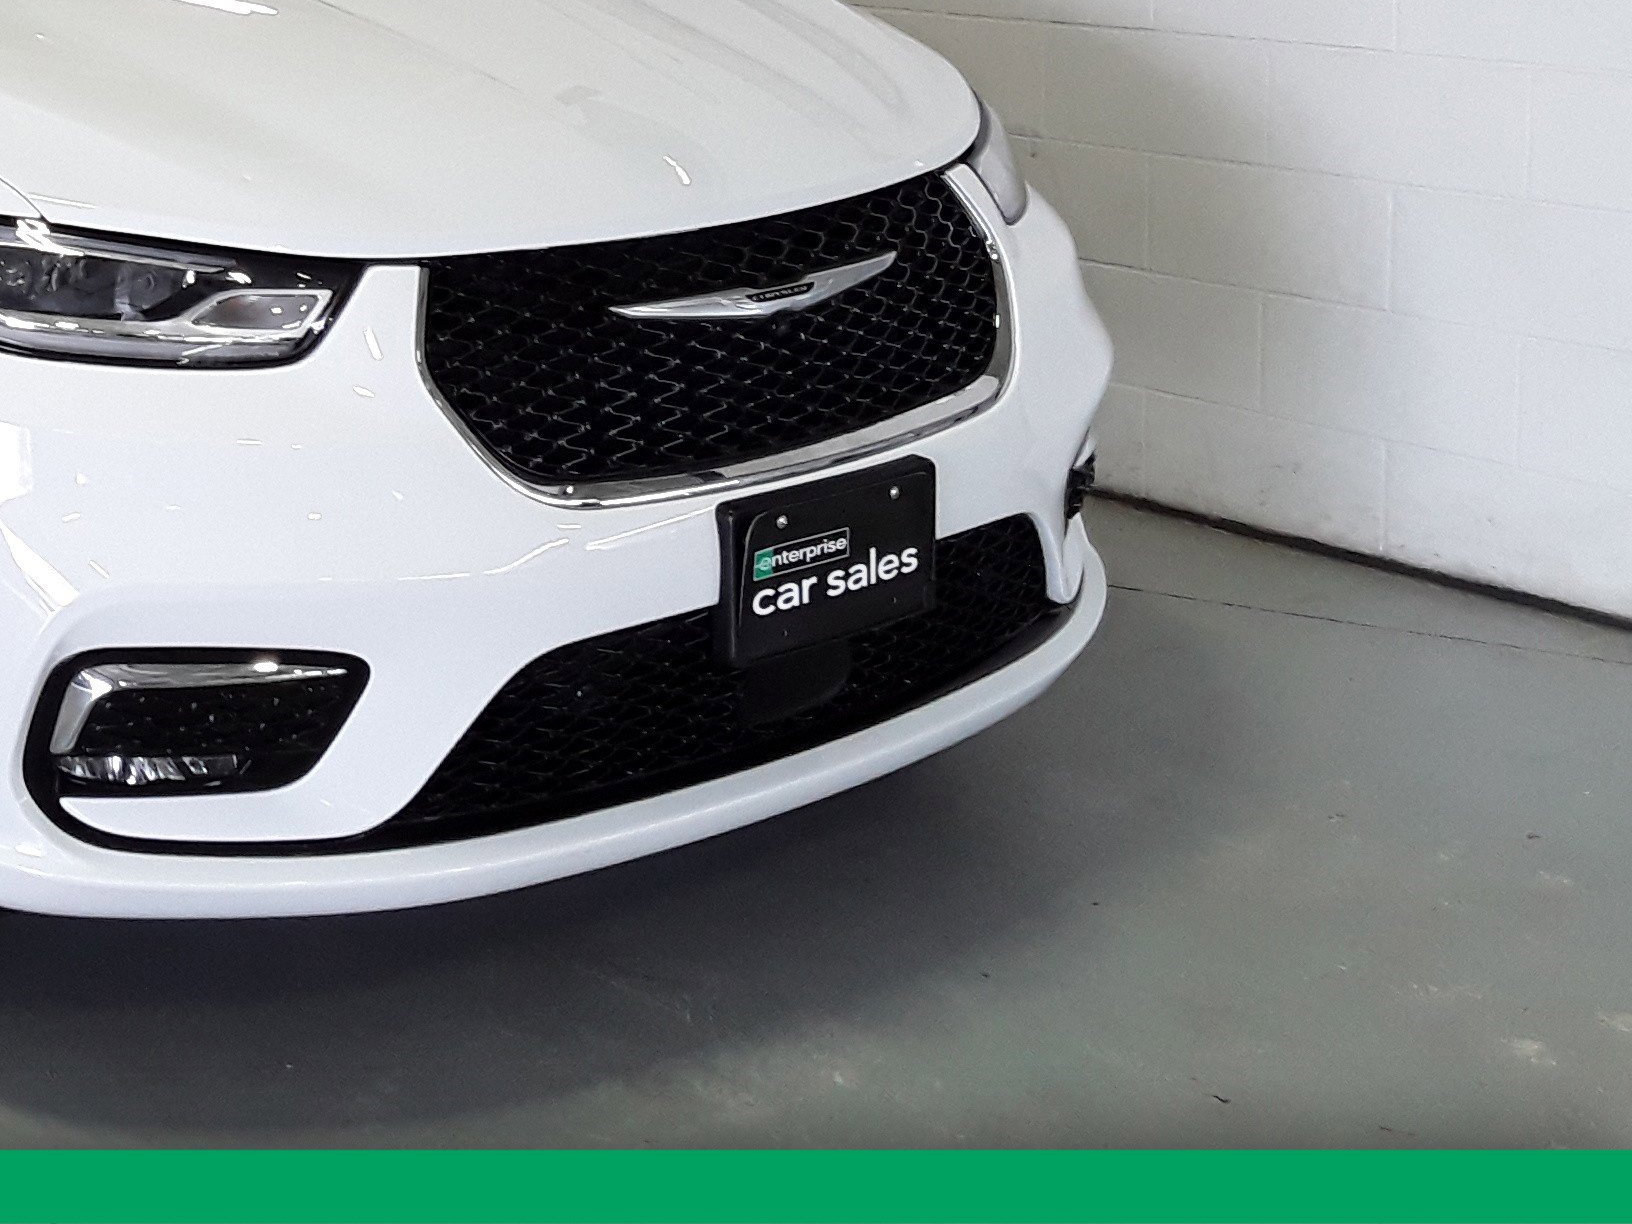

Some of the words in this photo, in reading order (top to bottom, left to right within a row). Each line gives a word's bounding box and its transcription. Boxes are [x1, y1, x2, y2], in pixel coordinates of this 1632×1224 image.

[756, 537, 848, 572] enterprise
[752, 576, 818, 616] car
[826, 546, 919, 597] sales
